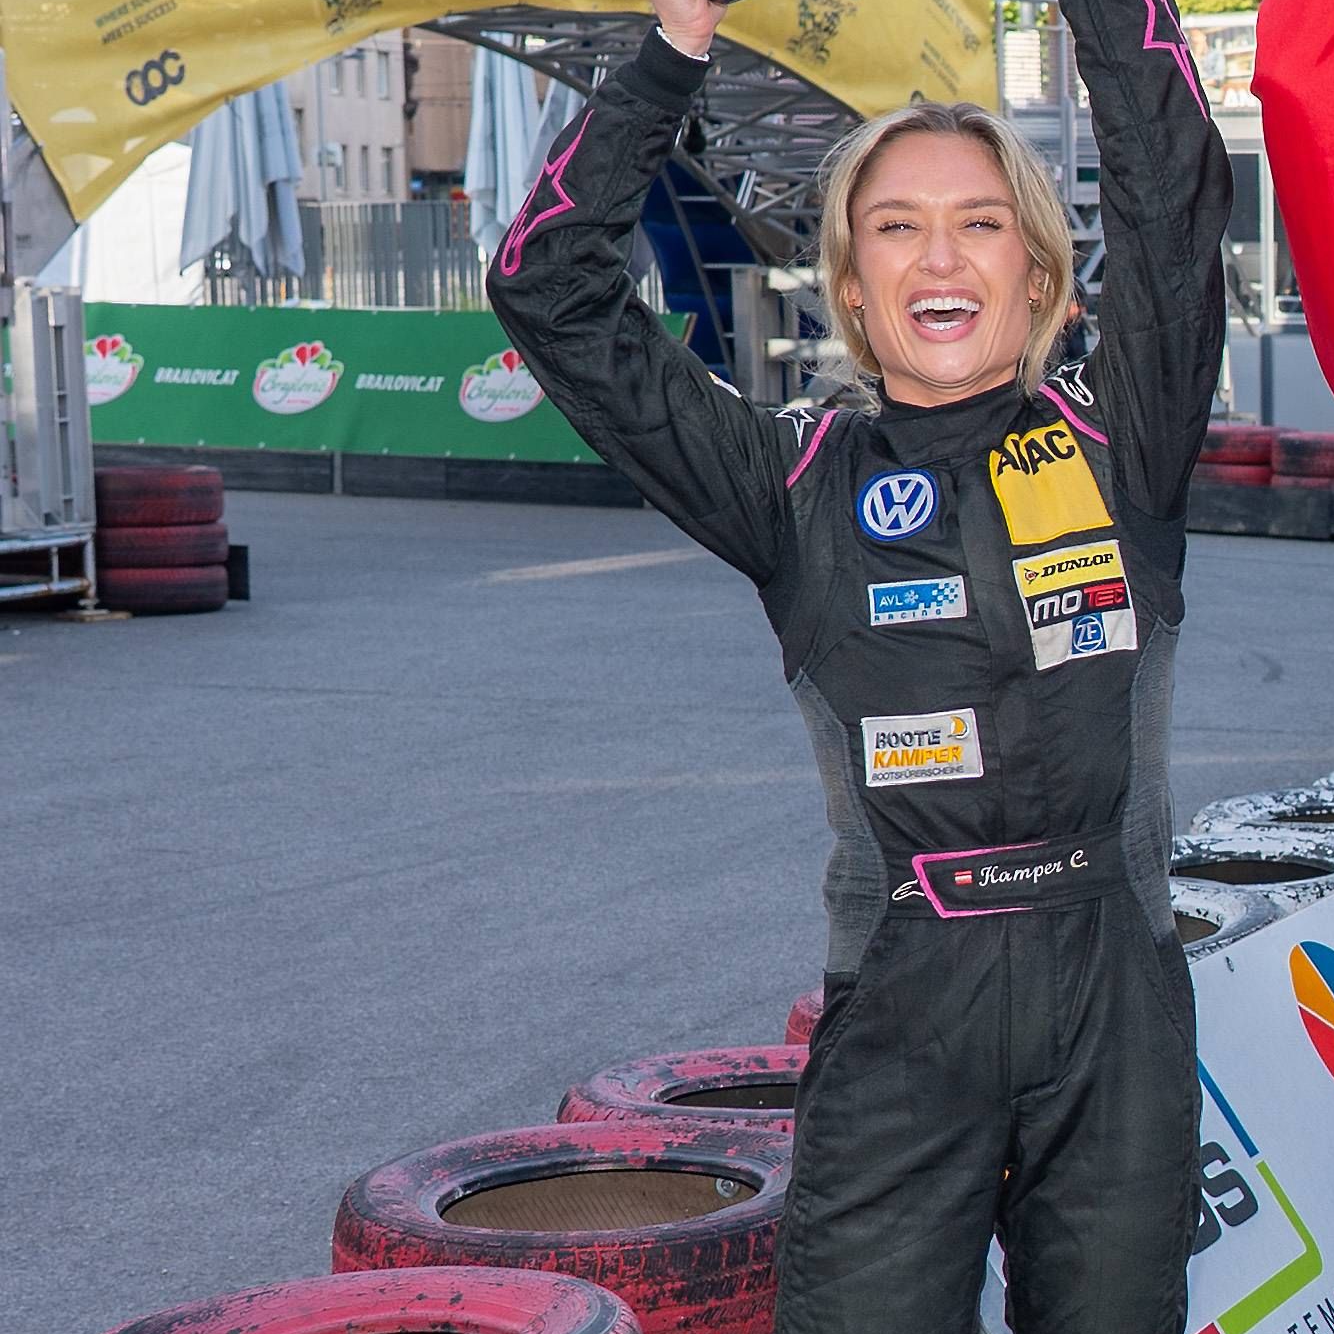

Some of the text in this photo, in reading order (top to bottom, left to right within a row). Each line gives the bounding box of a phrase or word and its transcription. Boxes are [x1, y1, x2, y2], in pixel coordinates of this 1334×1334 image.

[1041, 553, 1114, 578] DUNLOP
[879, 594, 903, 607] AVL
[875, 729, 941, 749] BOOTE
[873, 746, 963, 769] KAMPER
[978, 860, 1064, 887] Kamper
